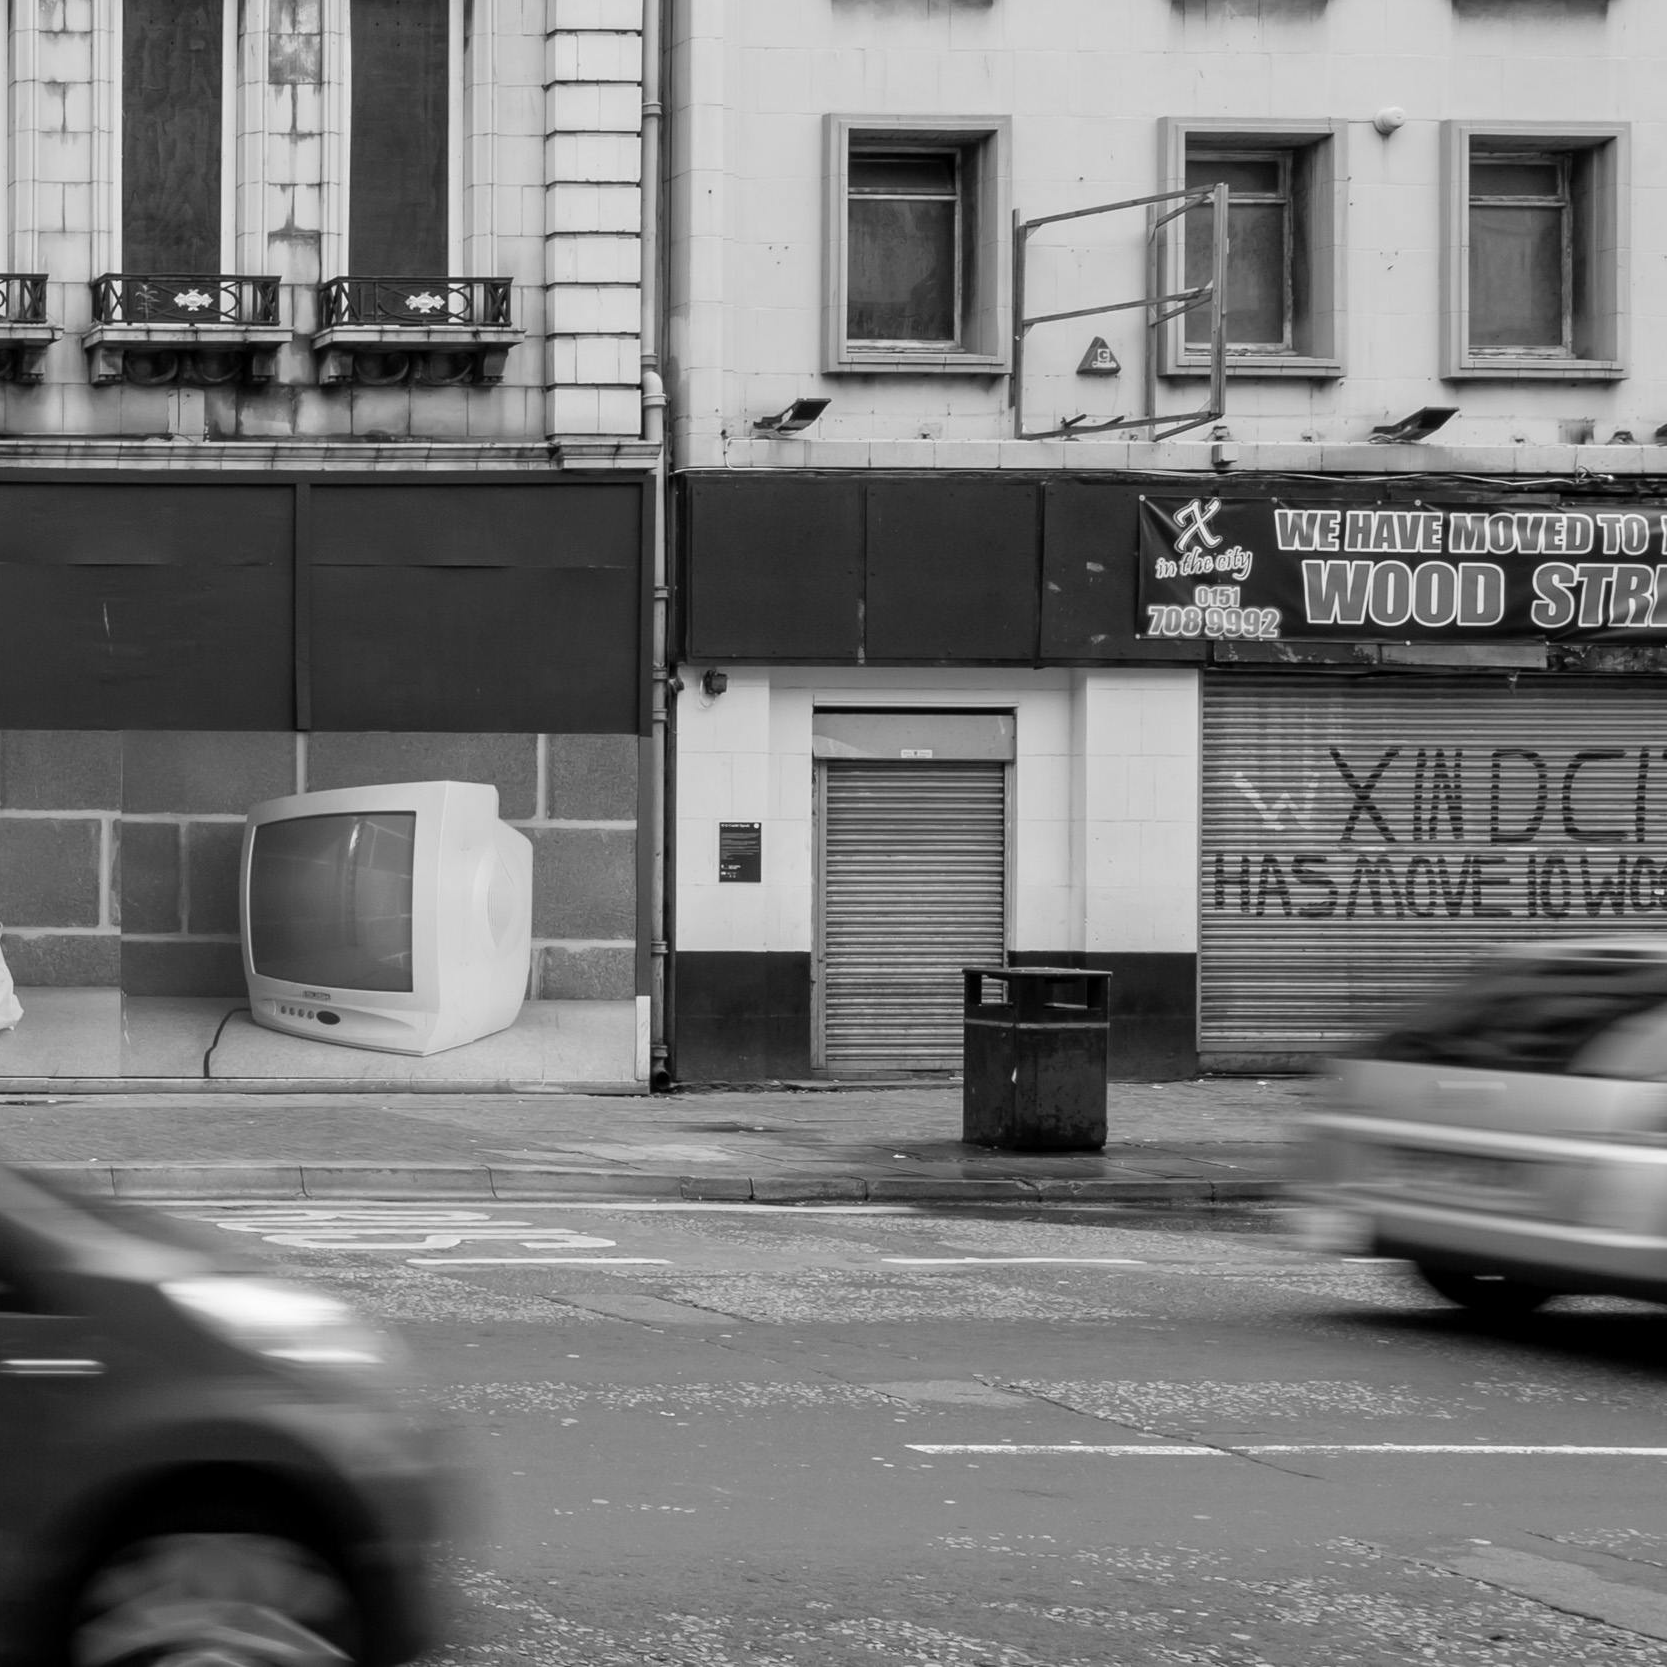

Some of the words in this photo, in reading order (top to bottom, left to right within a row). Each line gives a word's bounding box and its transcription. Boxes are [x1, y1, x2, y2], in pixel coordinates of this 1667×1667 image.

[1173, 497, 1223, 552] X
[1274, 509, 1341, 551] WE
[1344, 510, 1443, 553] HAVE
[1449, 512, 1594, 555] MOVED
[1596, 513, 1649, 556] TO
[1155, 556, 1178, 579] in
[1179, 546, 1214, 576] the
[1215, 545, 1253, 581] city
[1195, 585, 1241, 608] 0151
[1301, 560, 1505, 627] WOOD
[1147, 605, 1202, 636] 708
[1204, 606, 1281, 638] 9992
[1562, 746, 1667, 843] CI
[1213, 853, 1340, 918] HAS
[1579, 853, 1667, 918] WO
[163, 1210, 617, 1249] BUS
